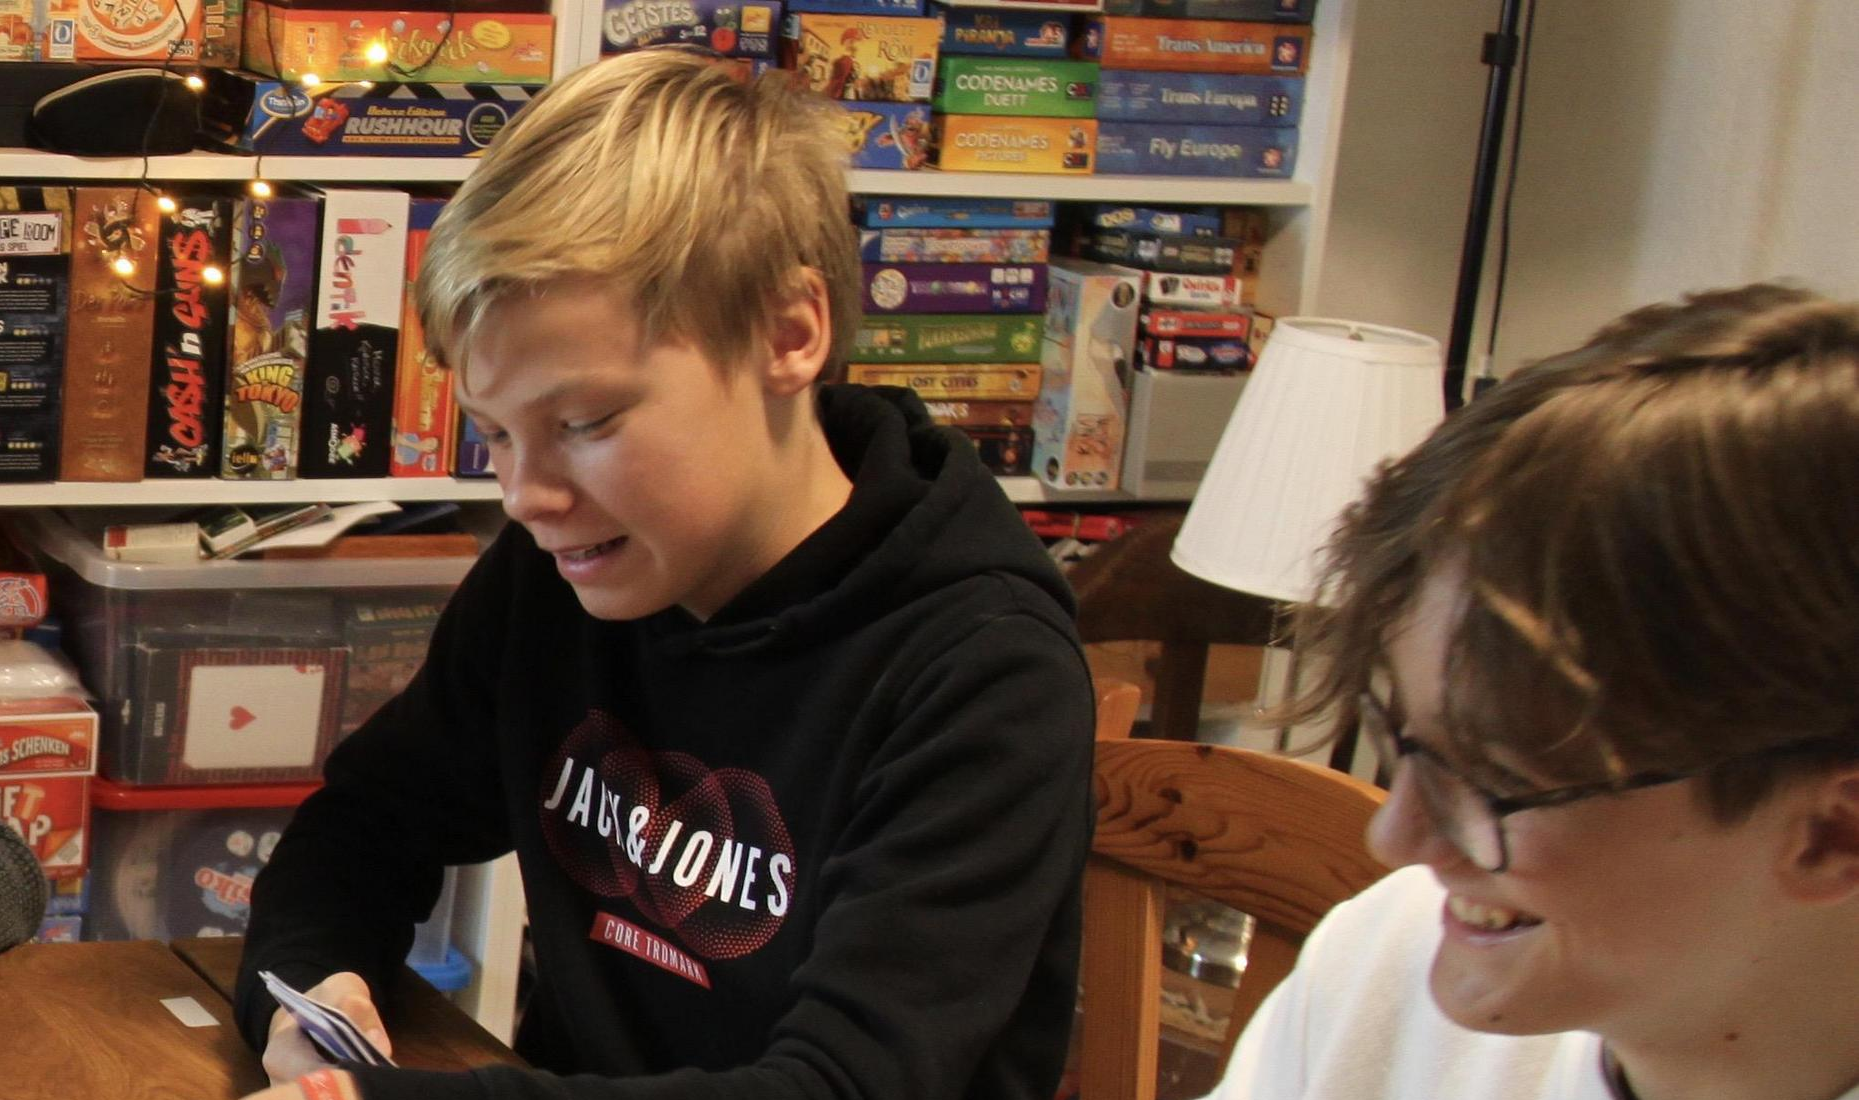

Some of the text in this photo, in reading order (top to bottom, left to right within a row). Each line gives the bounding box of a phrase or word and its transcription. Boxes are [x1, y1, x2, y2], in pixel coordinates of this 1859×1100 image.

[956, 74, 1059, 93] CODENAMES
[954, 133, 1049, 150] CODENAMES
[1149, 138, 1176, 160] Fly
[247, 364, 295, 386] KING
[236, 383, 300, 414] TOKYO
[12, 735, 70, 761] SCHENKEN
[603, 918, 640, 952] CORE
